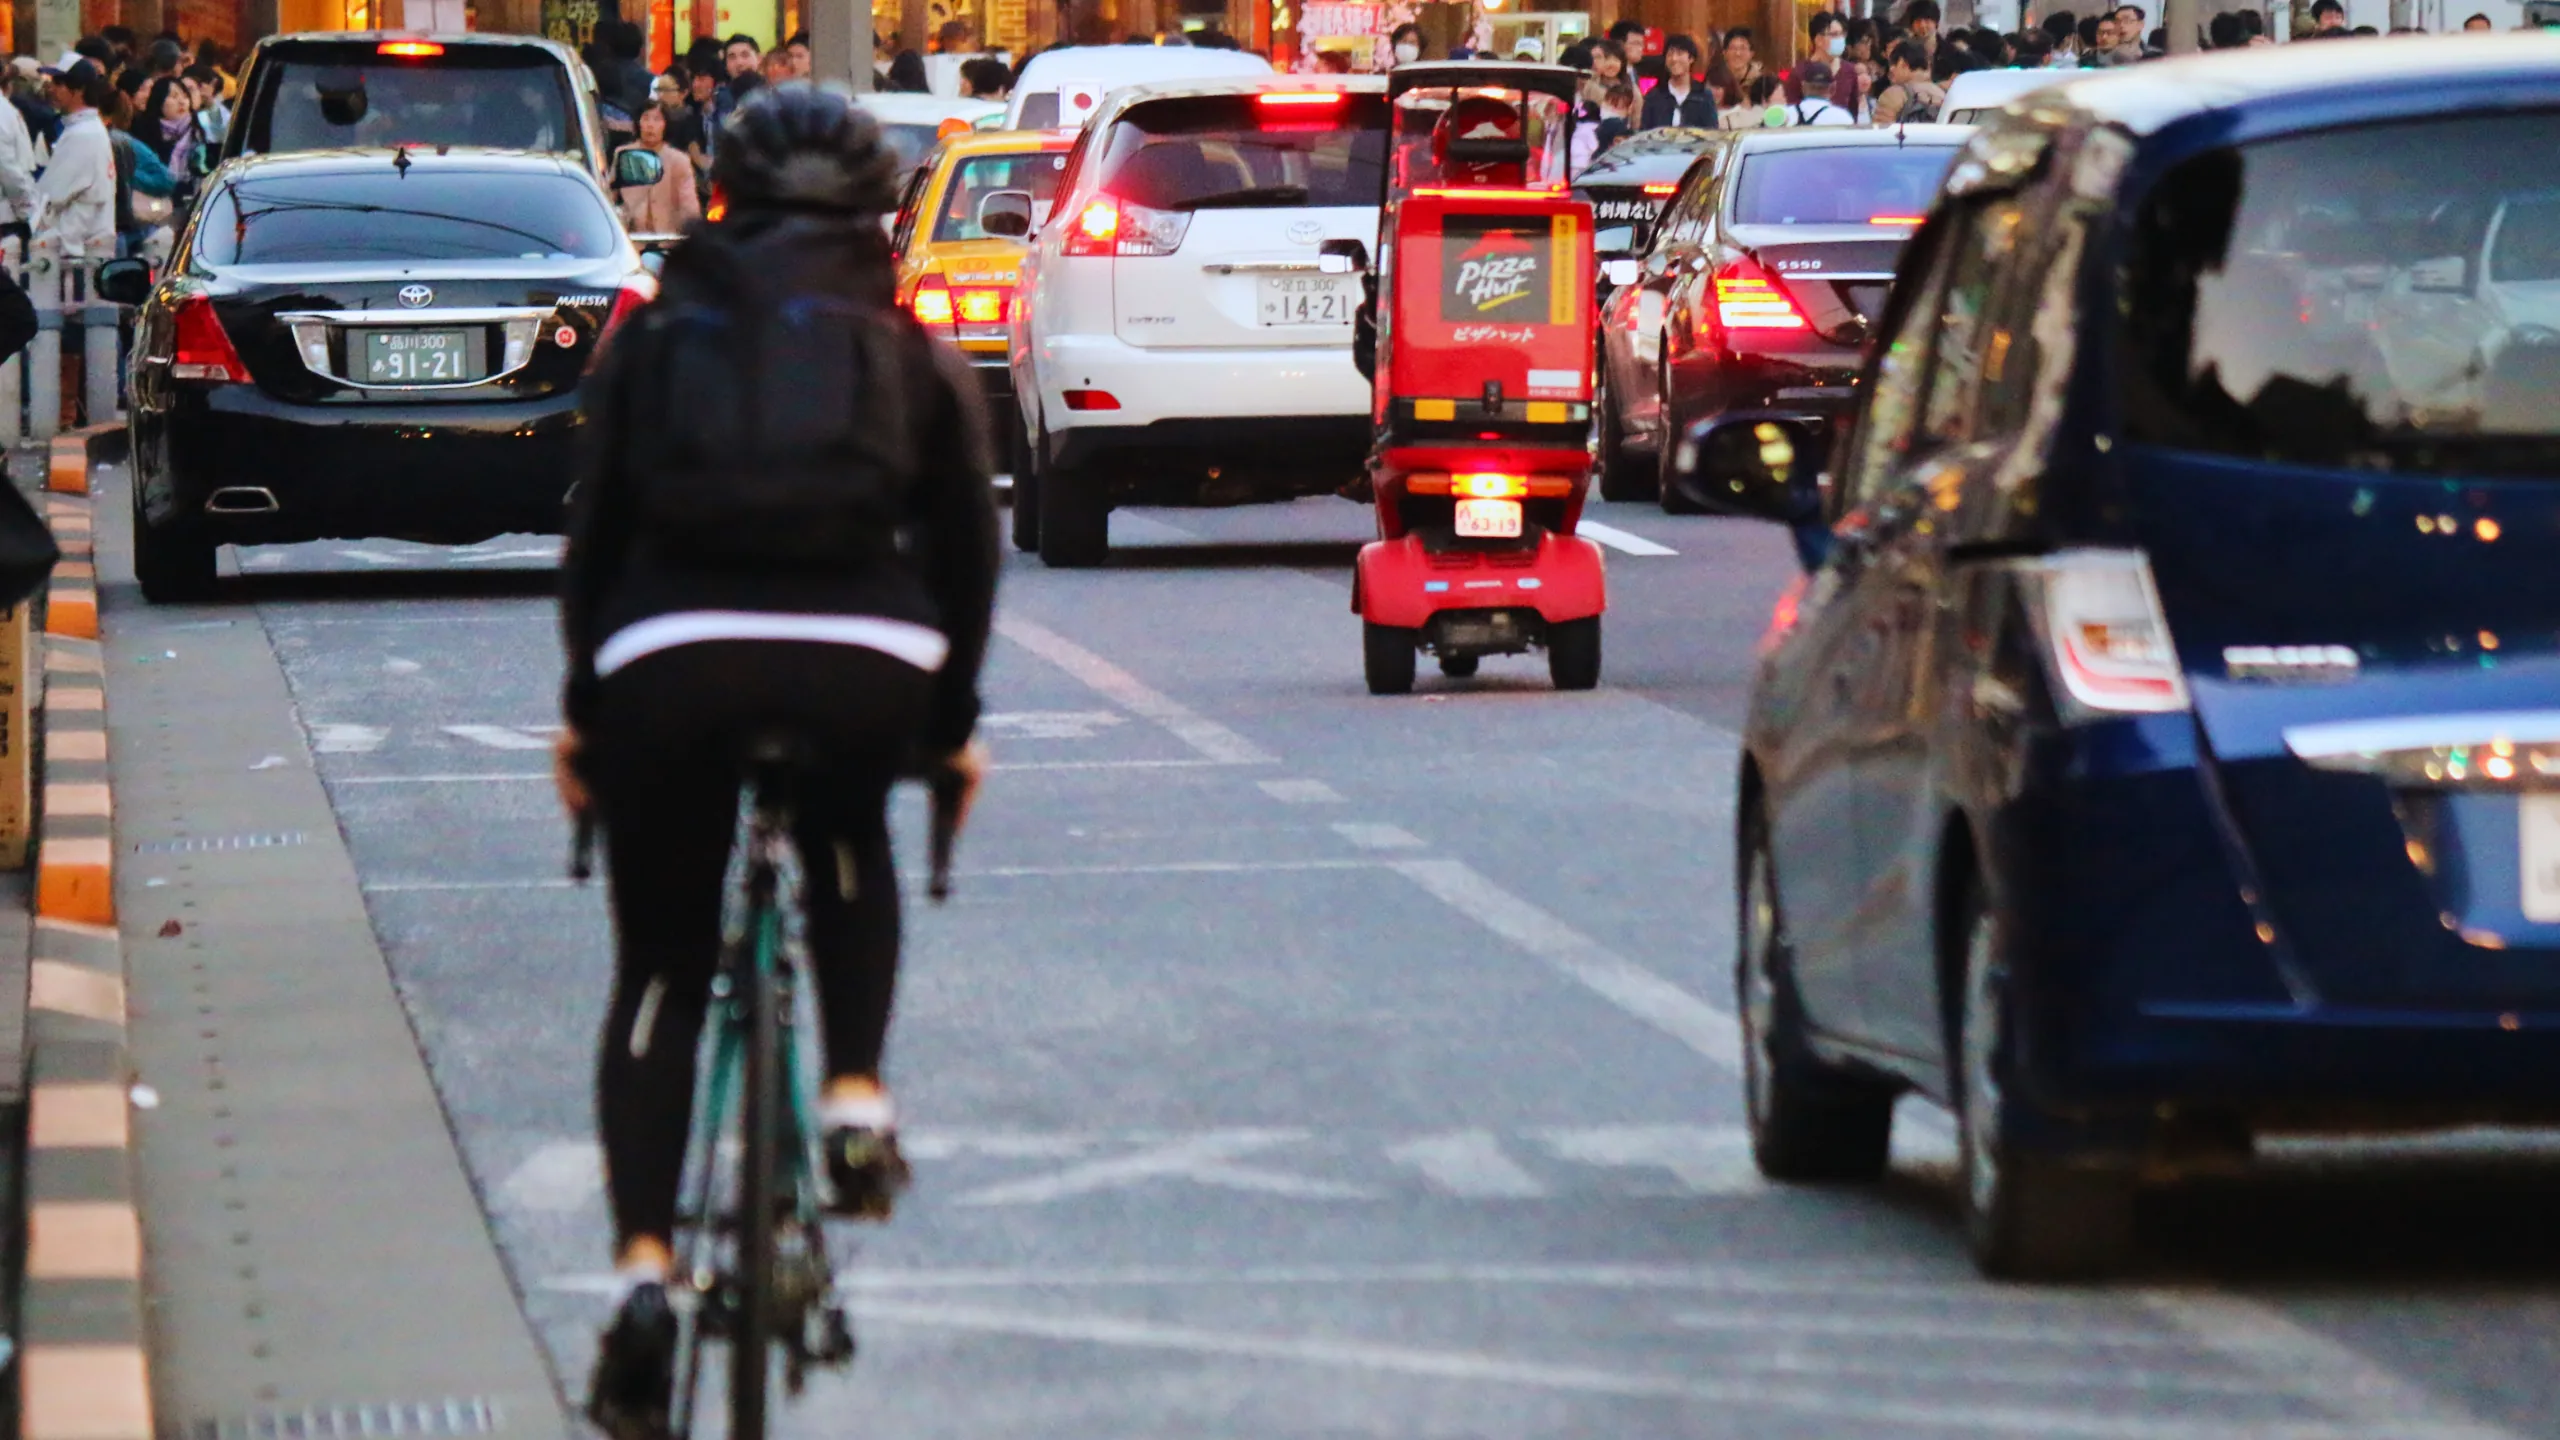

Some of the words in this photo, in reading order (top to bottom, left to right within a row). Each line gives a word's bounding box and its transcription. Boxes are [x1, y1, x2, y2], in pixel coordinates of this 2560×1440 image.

[1455, 252, 1536, 295] Pizza
[555, 295, 608, 308] MAJESTA
[1470, 274, 1528, 305] Hut
[1284, 295, 1346, 319] 14-21
[388, 351, 459, 379] 91-21
